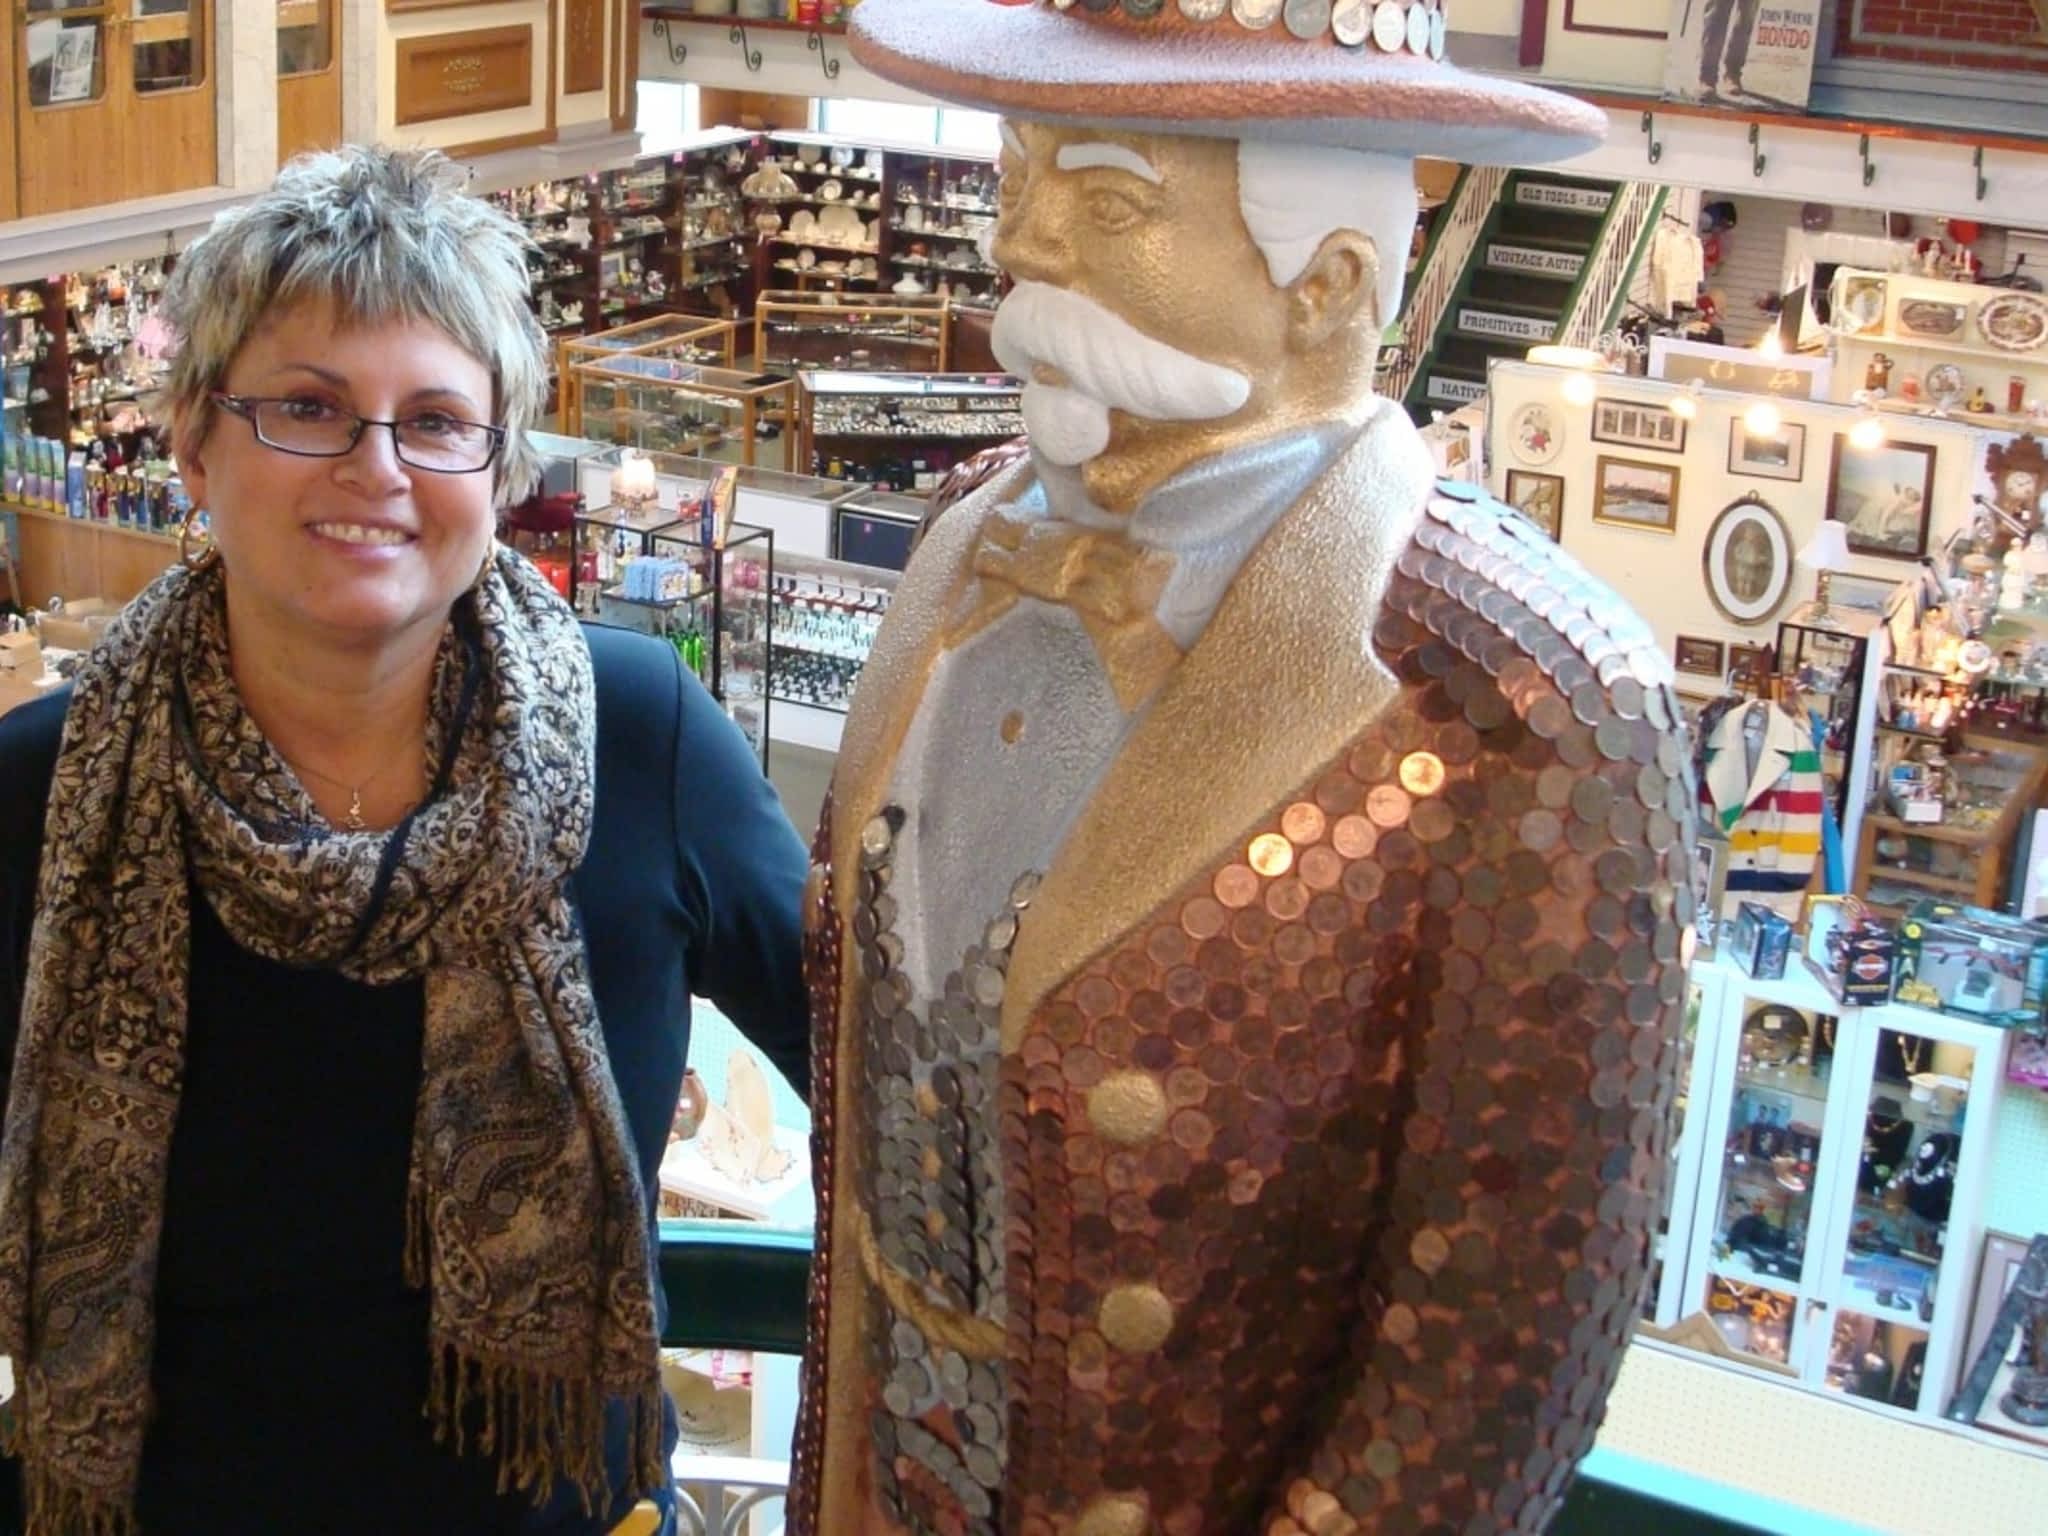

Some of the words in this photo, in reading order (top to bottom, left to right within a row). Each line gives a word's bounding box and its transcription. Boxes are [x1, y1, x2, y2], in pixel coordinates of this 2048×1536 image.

[1757, 26, 1810, 50] HONDO
[1544, 189, 1577, 205] TOOLS
[1493, 249, 1543, 267] VINTAGE
[1463, 314, 1530, 336] PRIMITIVES
